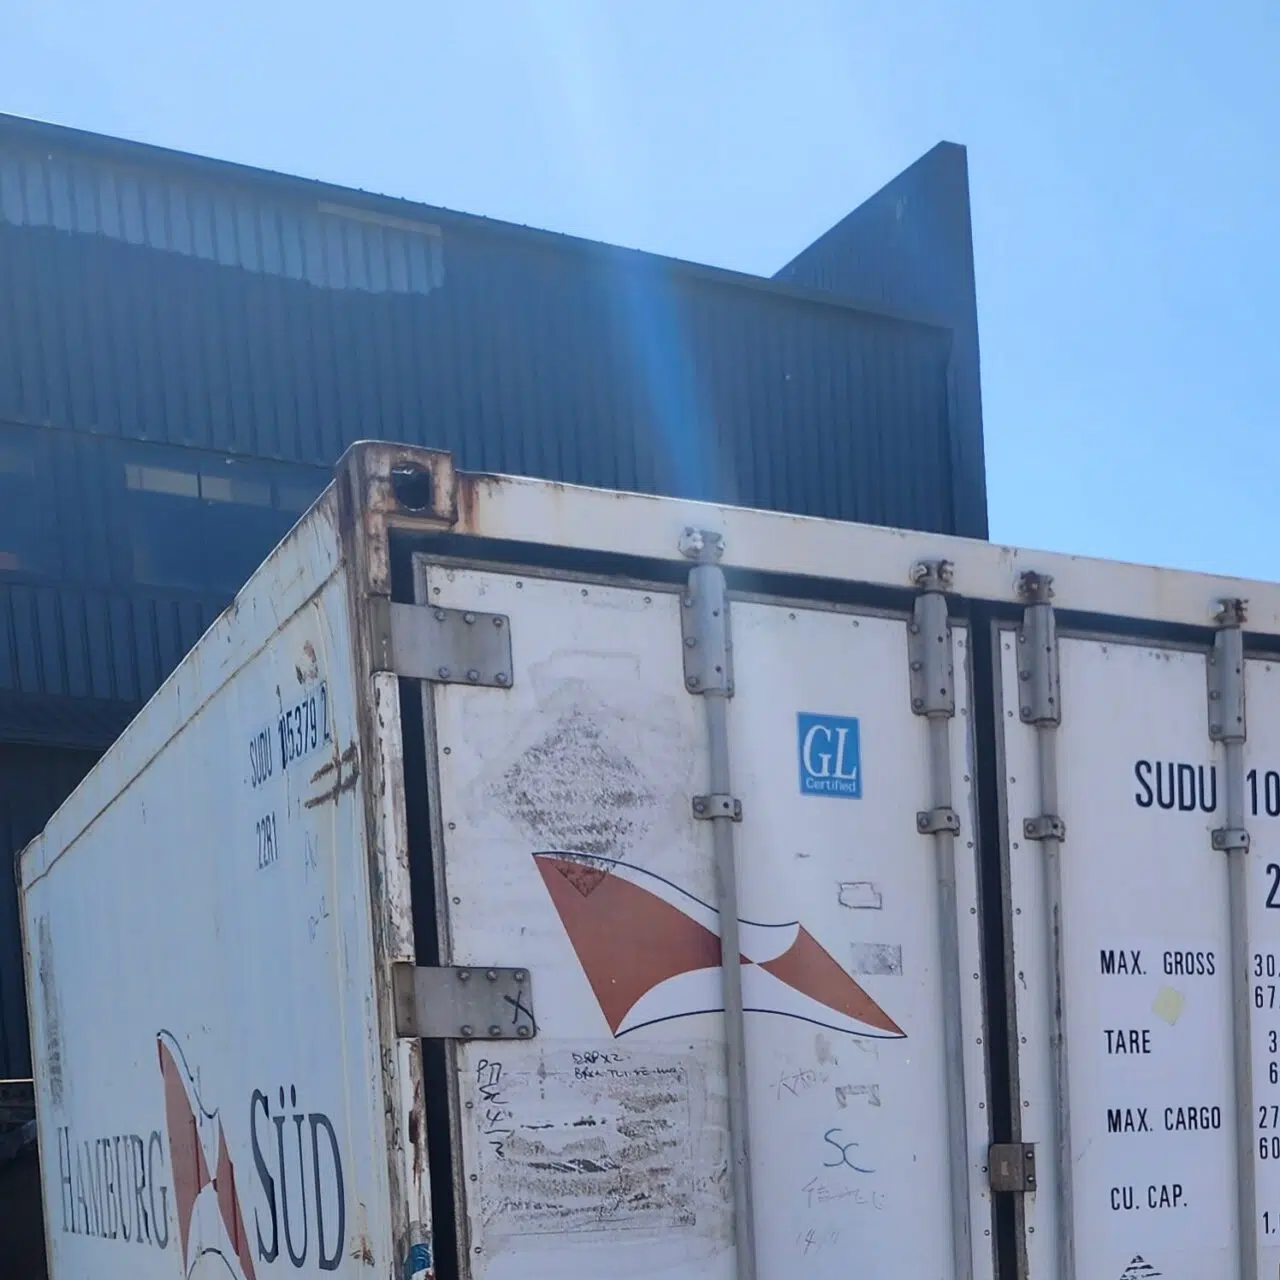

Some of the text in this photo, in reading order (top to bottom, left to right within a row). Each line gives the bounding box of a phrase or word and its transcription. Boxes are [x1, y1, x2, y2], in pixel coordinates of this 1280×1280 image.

[249, 727, 273, 789] SUDU
[319, 684, 330, 742] 2
[803, 724, 857, 779] GL
[805, 776, 856, 792] Certified
[1134, 759, 1218, 813] SUDU
[255, 811, 279, 871] 22R1
[1100, 949, 1147, 976] MAX.
[1163, 951, 1216, 976] GROSS
[1103, 1029, 1151, 1054] TARE
[1107, 1107, 1153, 1133] MAX.
[1164, 1105, 1221, 1131] CARGO
[57, 1083, 346, 1272] HAMBURG SÜD
[1110, 1186, 1140, 1211] CU.
[1148, 1184, 1188, 1209] CAP.
